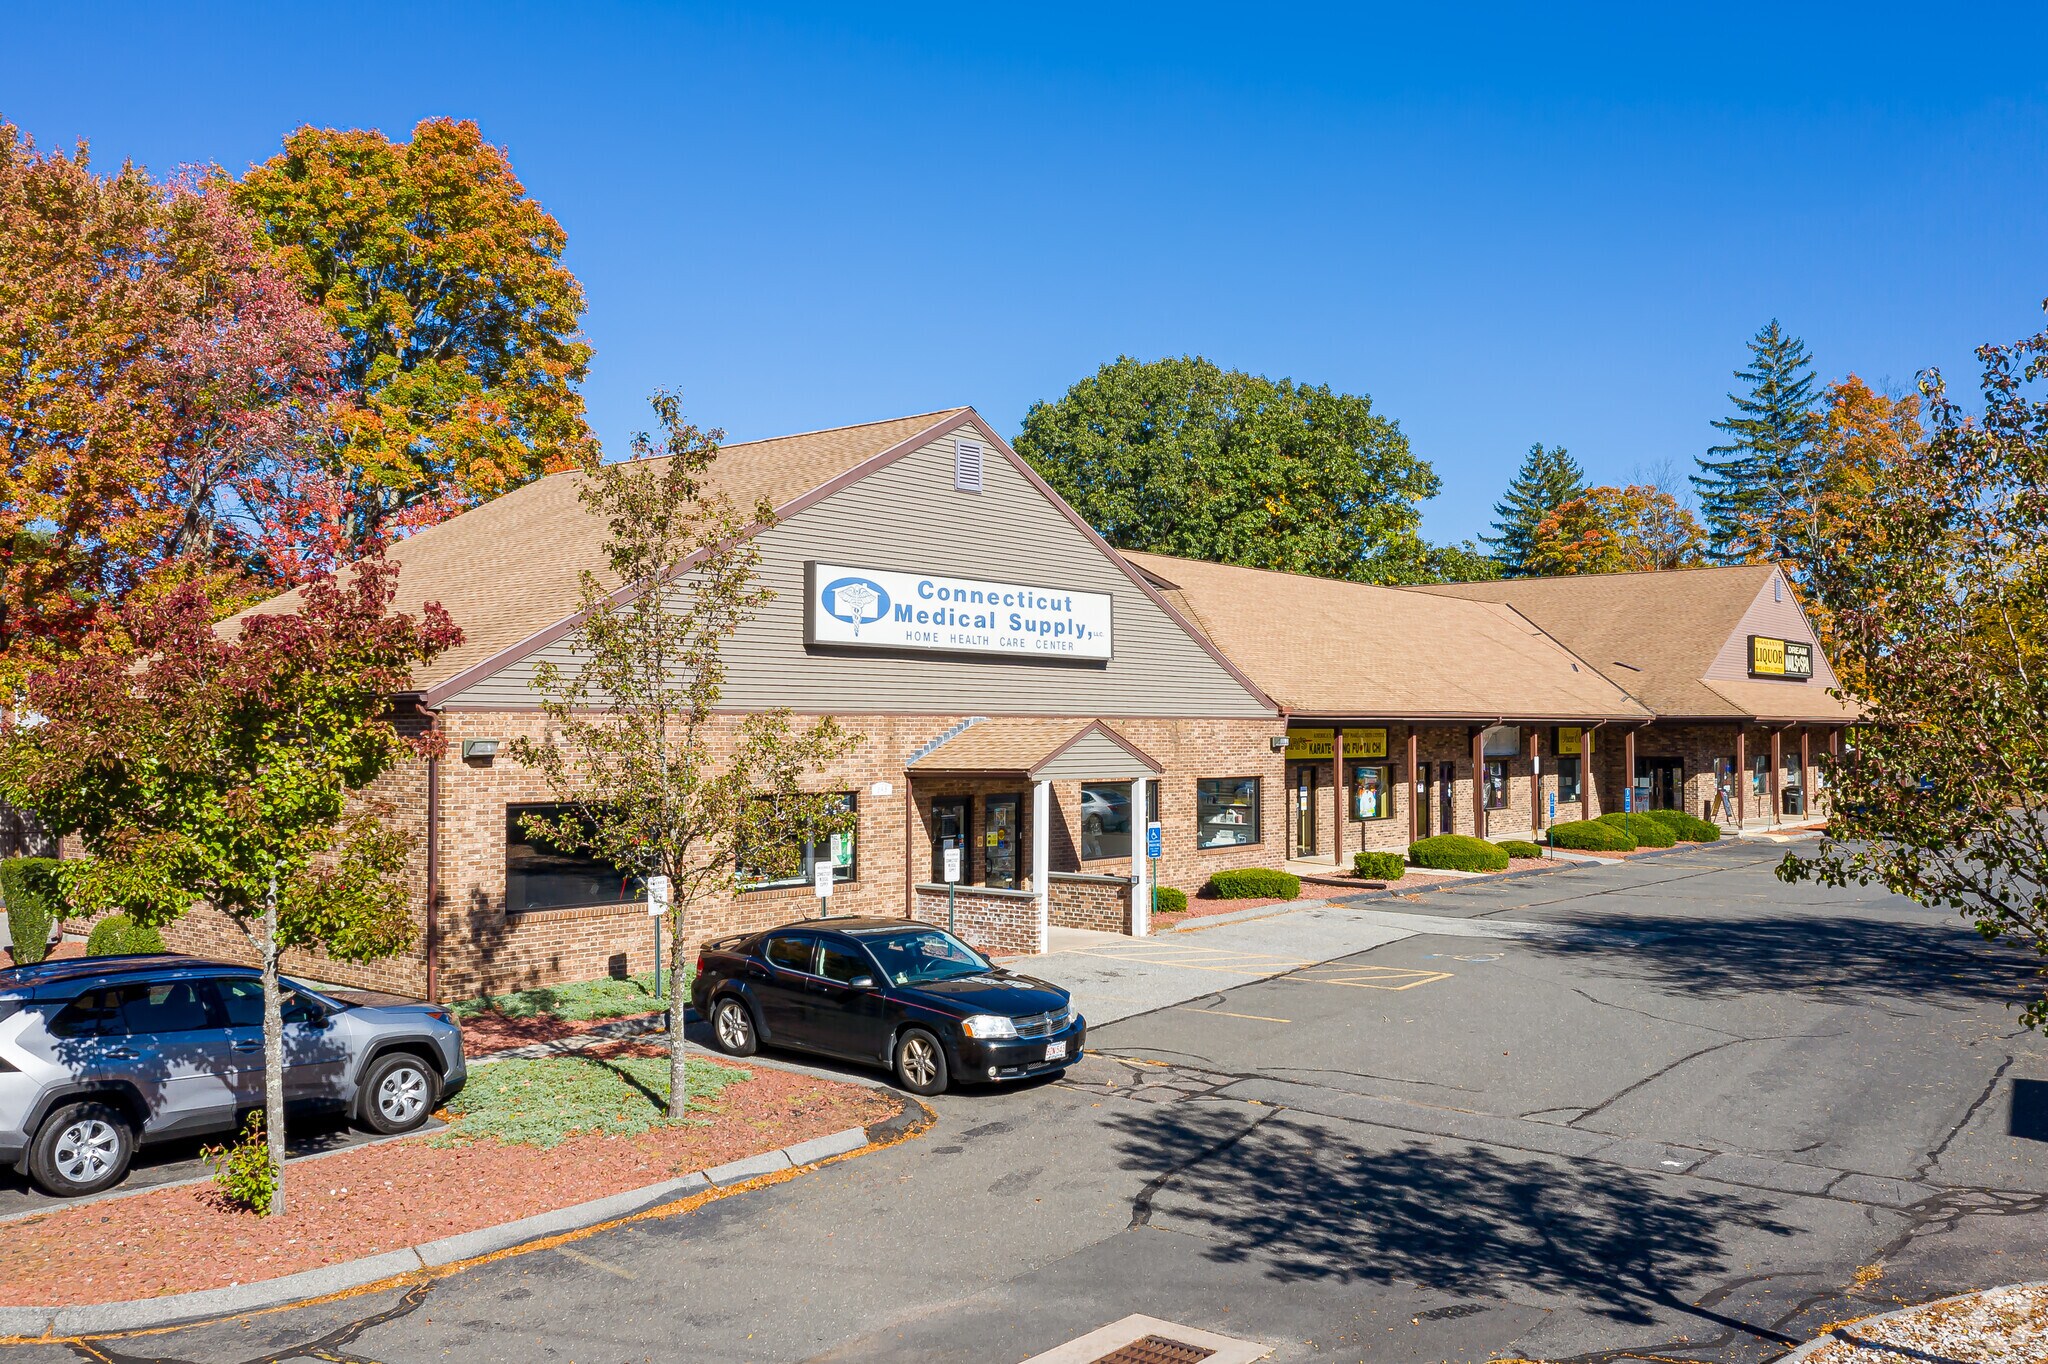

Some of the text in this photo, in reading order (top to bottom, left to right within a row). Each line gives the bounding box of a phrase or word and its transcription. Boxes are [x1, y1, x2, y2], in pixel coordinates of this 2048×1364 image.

[917, 580, 1071, 612] Connecticut
[894, 603, 995, 629] Medical
[1009, 613, 1092, 640] Supply,
[906, 631, 1074, 651] HOME HEALTH CARE CENTER
[1756, 648, 1783, 665] LIQUOR
[1788, 646, 1808, 655] DREAM
[1309, 742, 1332, 755] KARATE
